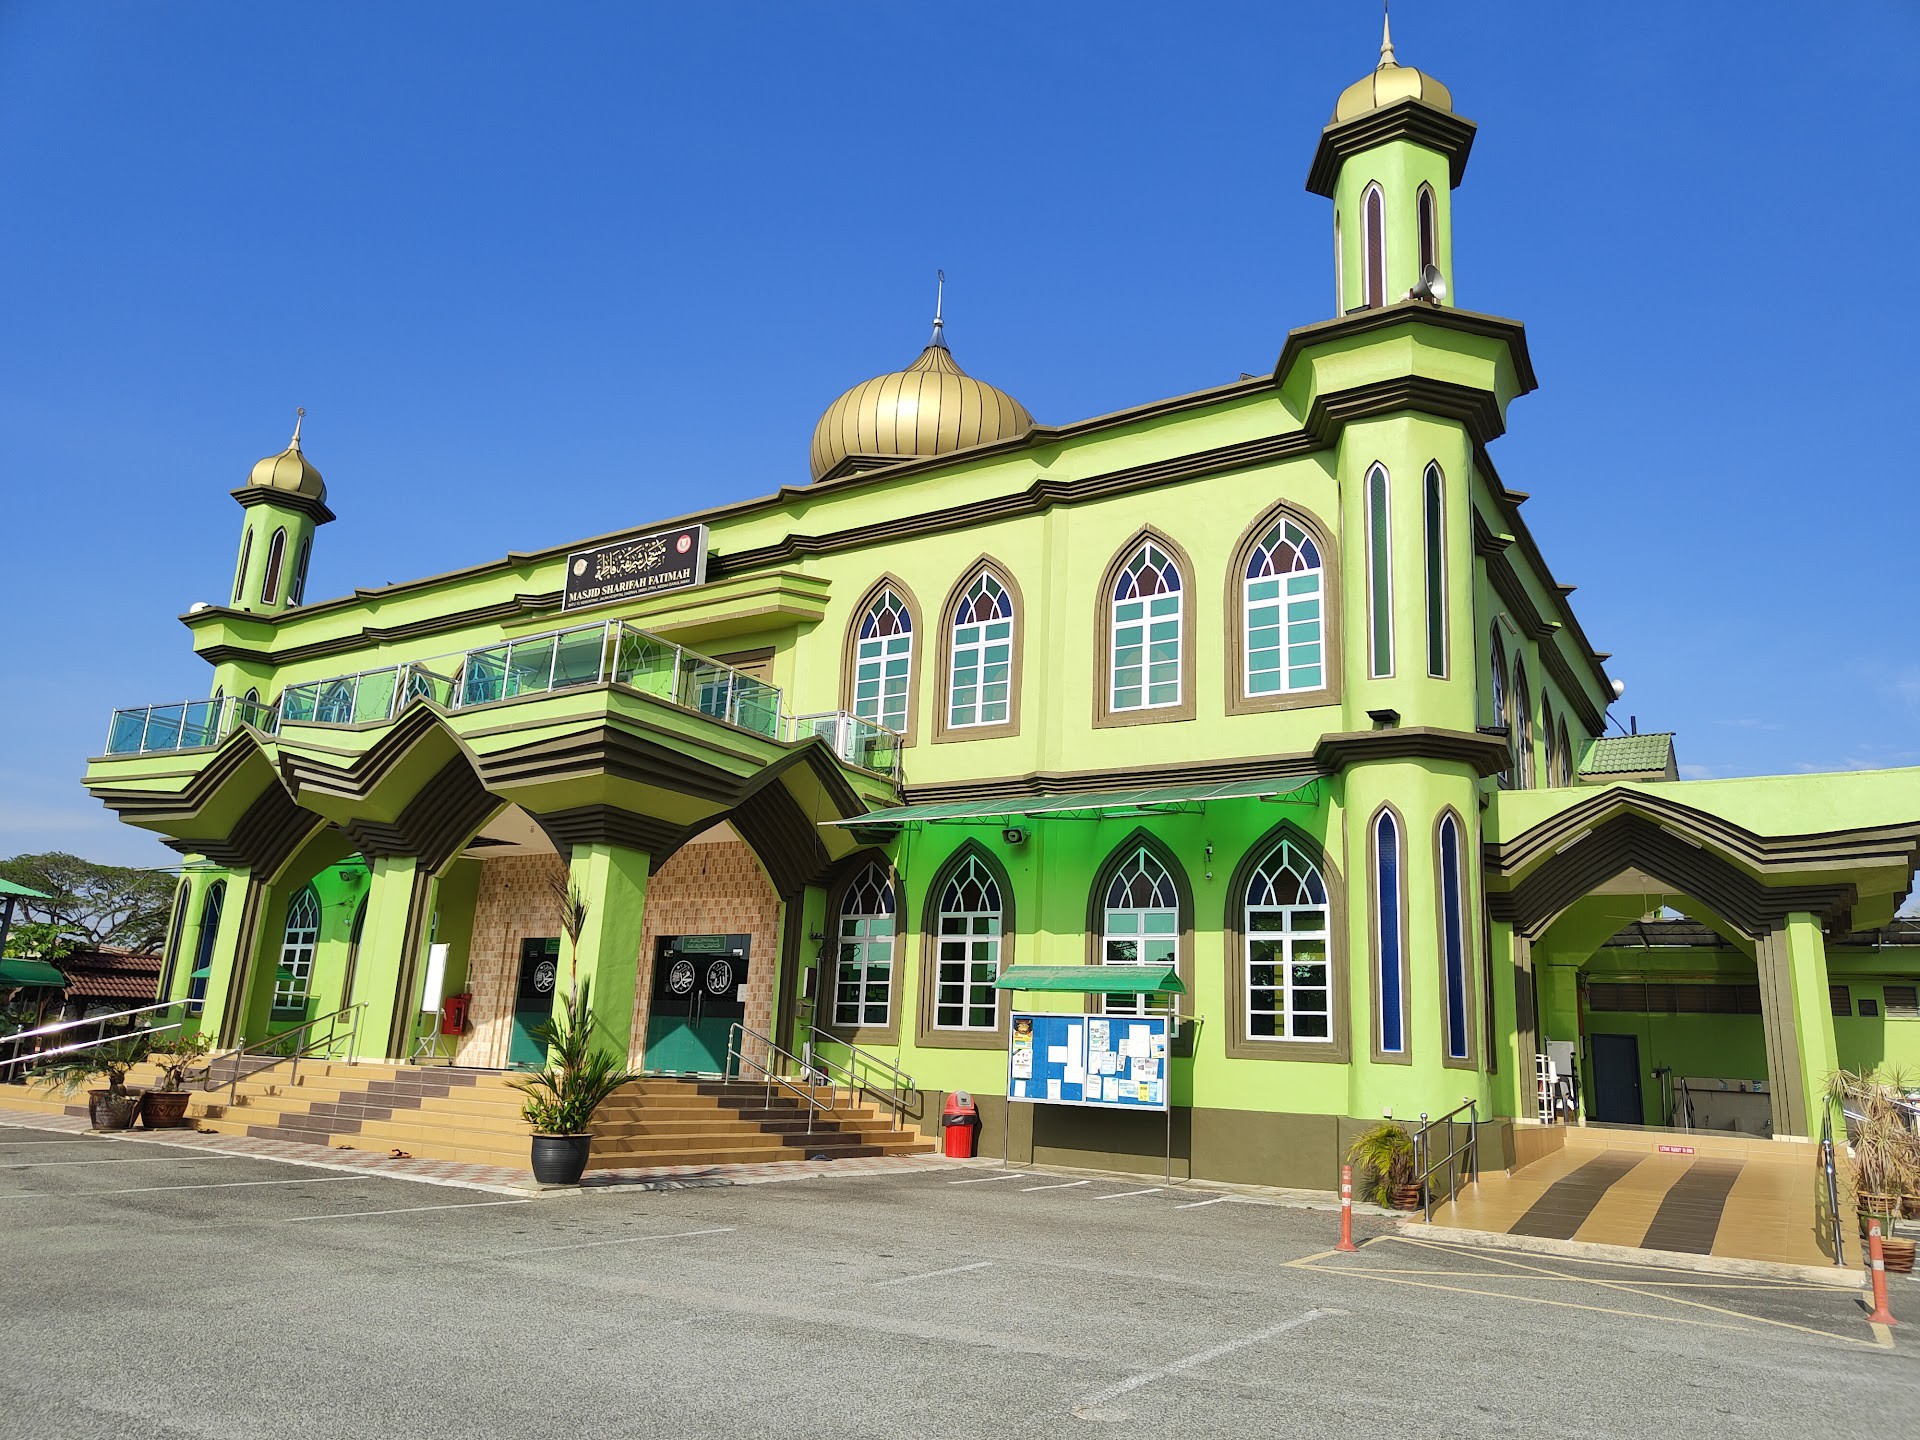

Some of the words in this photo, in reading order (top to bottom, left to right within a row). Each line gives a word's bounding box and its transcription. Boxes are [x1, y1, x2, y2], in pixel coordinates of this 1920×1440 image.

[569, 587, 600, 602] MASJID
[601, 577, 646, 596] SHARIFAH
[648, 568, 691, 585] FATIMAH
